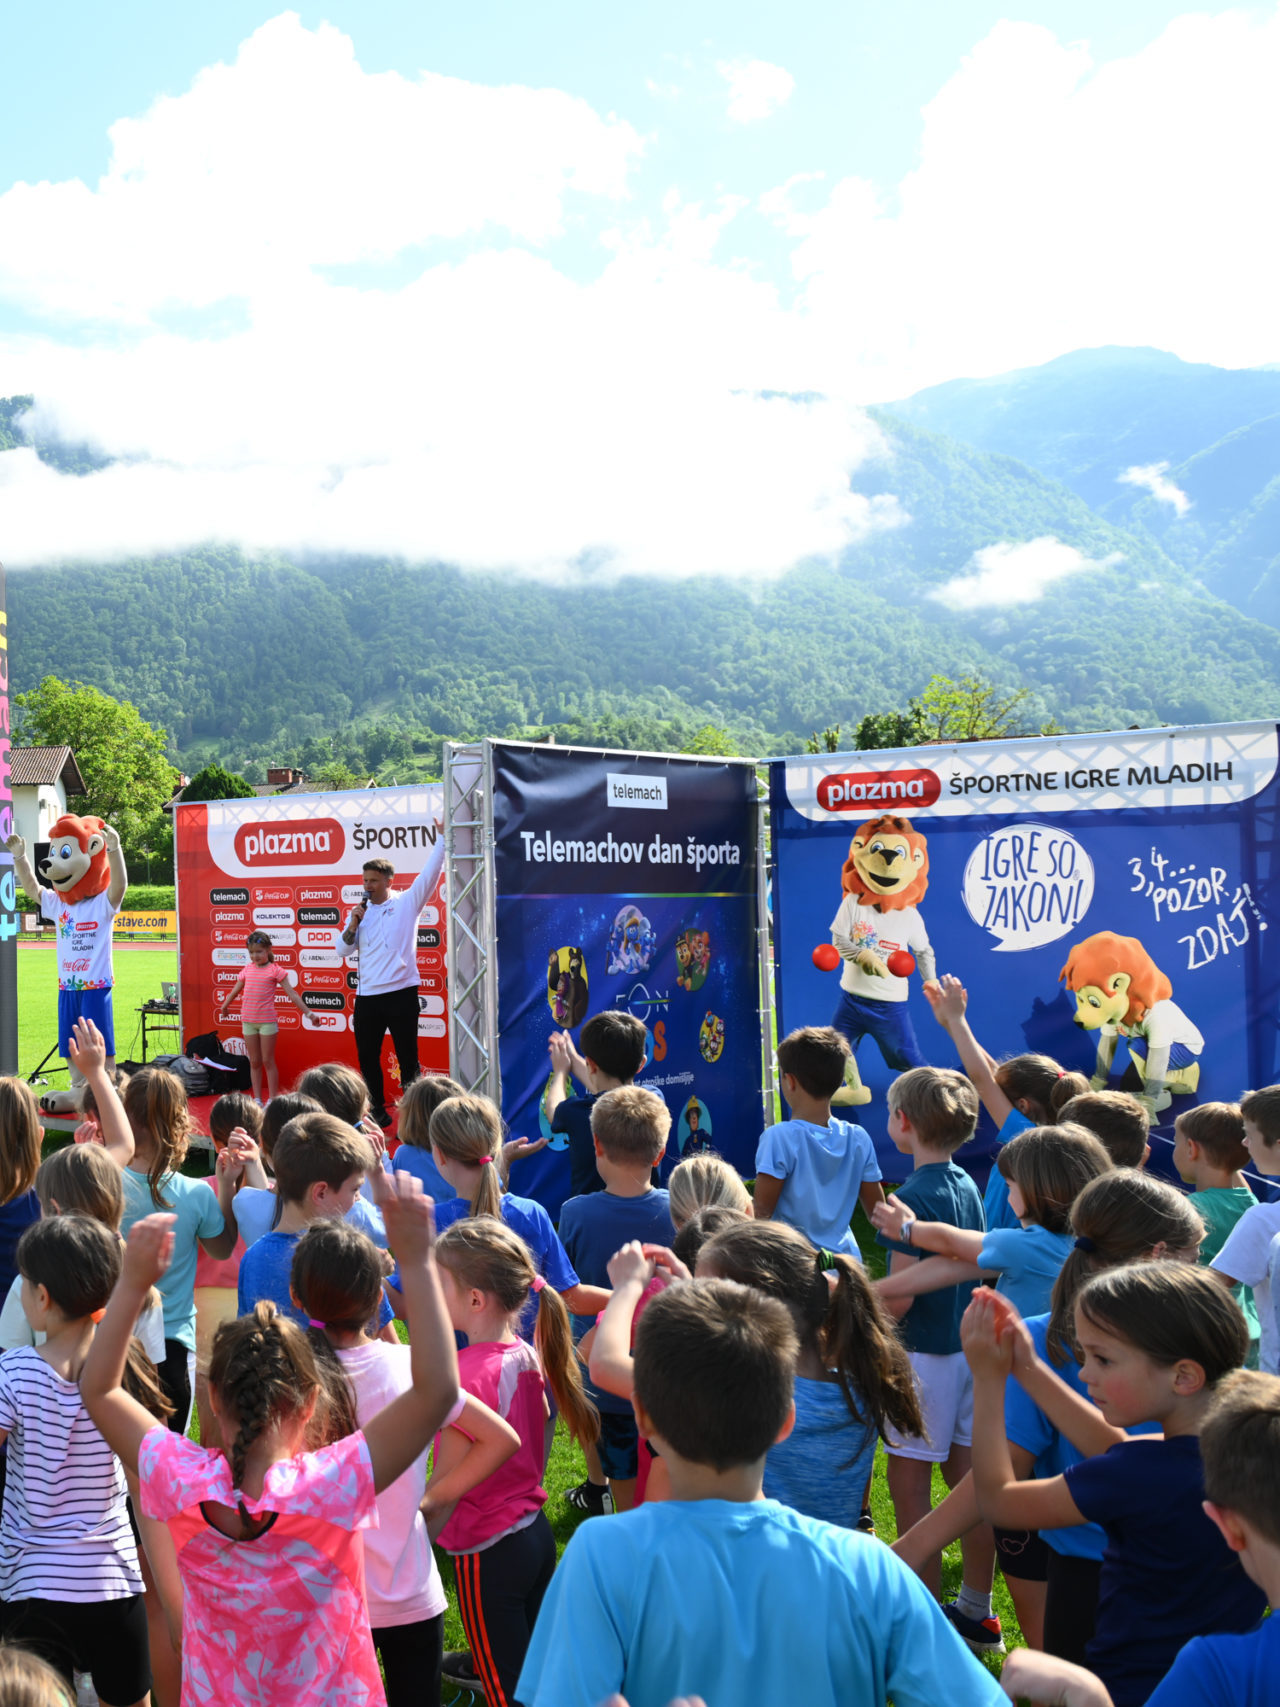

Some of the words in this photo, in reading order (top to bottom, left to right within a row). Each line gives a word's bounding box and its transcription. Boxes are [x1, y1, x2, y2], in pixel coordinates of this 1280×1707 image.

[827, 779, 925, 807] plazma
[949, 772, 1058, 795] ŠPORTNE
[1065, 768, 1120, 789] IGRE
[1127, 761, 1233, 786] MLADIH
[613, 783, 662, 801] telemach
[244, 828, 330, 862] plazma
[352, 822, 438, 851] ŠPORTN
[520, 830, 645, 863] Telemachov
[648, 833, 682, 864] dan
[686, 836, 740, 873] športa
[980, 831, 1042, 881] IGRE
[1046, 839, 1076, 879] SO
[213, 892, 247, 901] telemach
[300, 890, 332, 902] plazma
[981, 879, 1084, 932] ZAKON!
[215, 911, 245, 923] plazma
[300, 912, 337, 921] telemach
[1177, 882, 1269, 970] ZDAJ!
[274, 954, 291, 962] zma
[305, 996, 341, 1006] telemach
[320, 1016, 337, 1027] op
